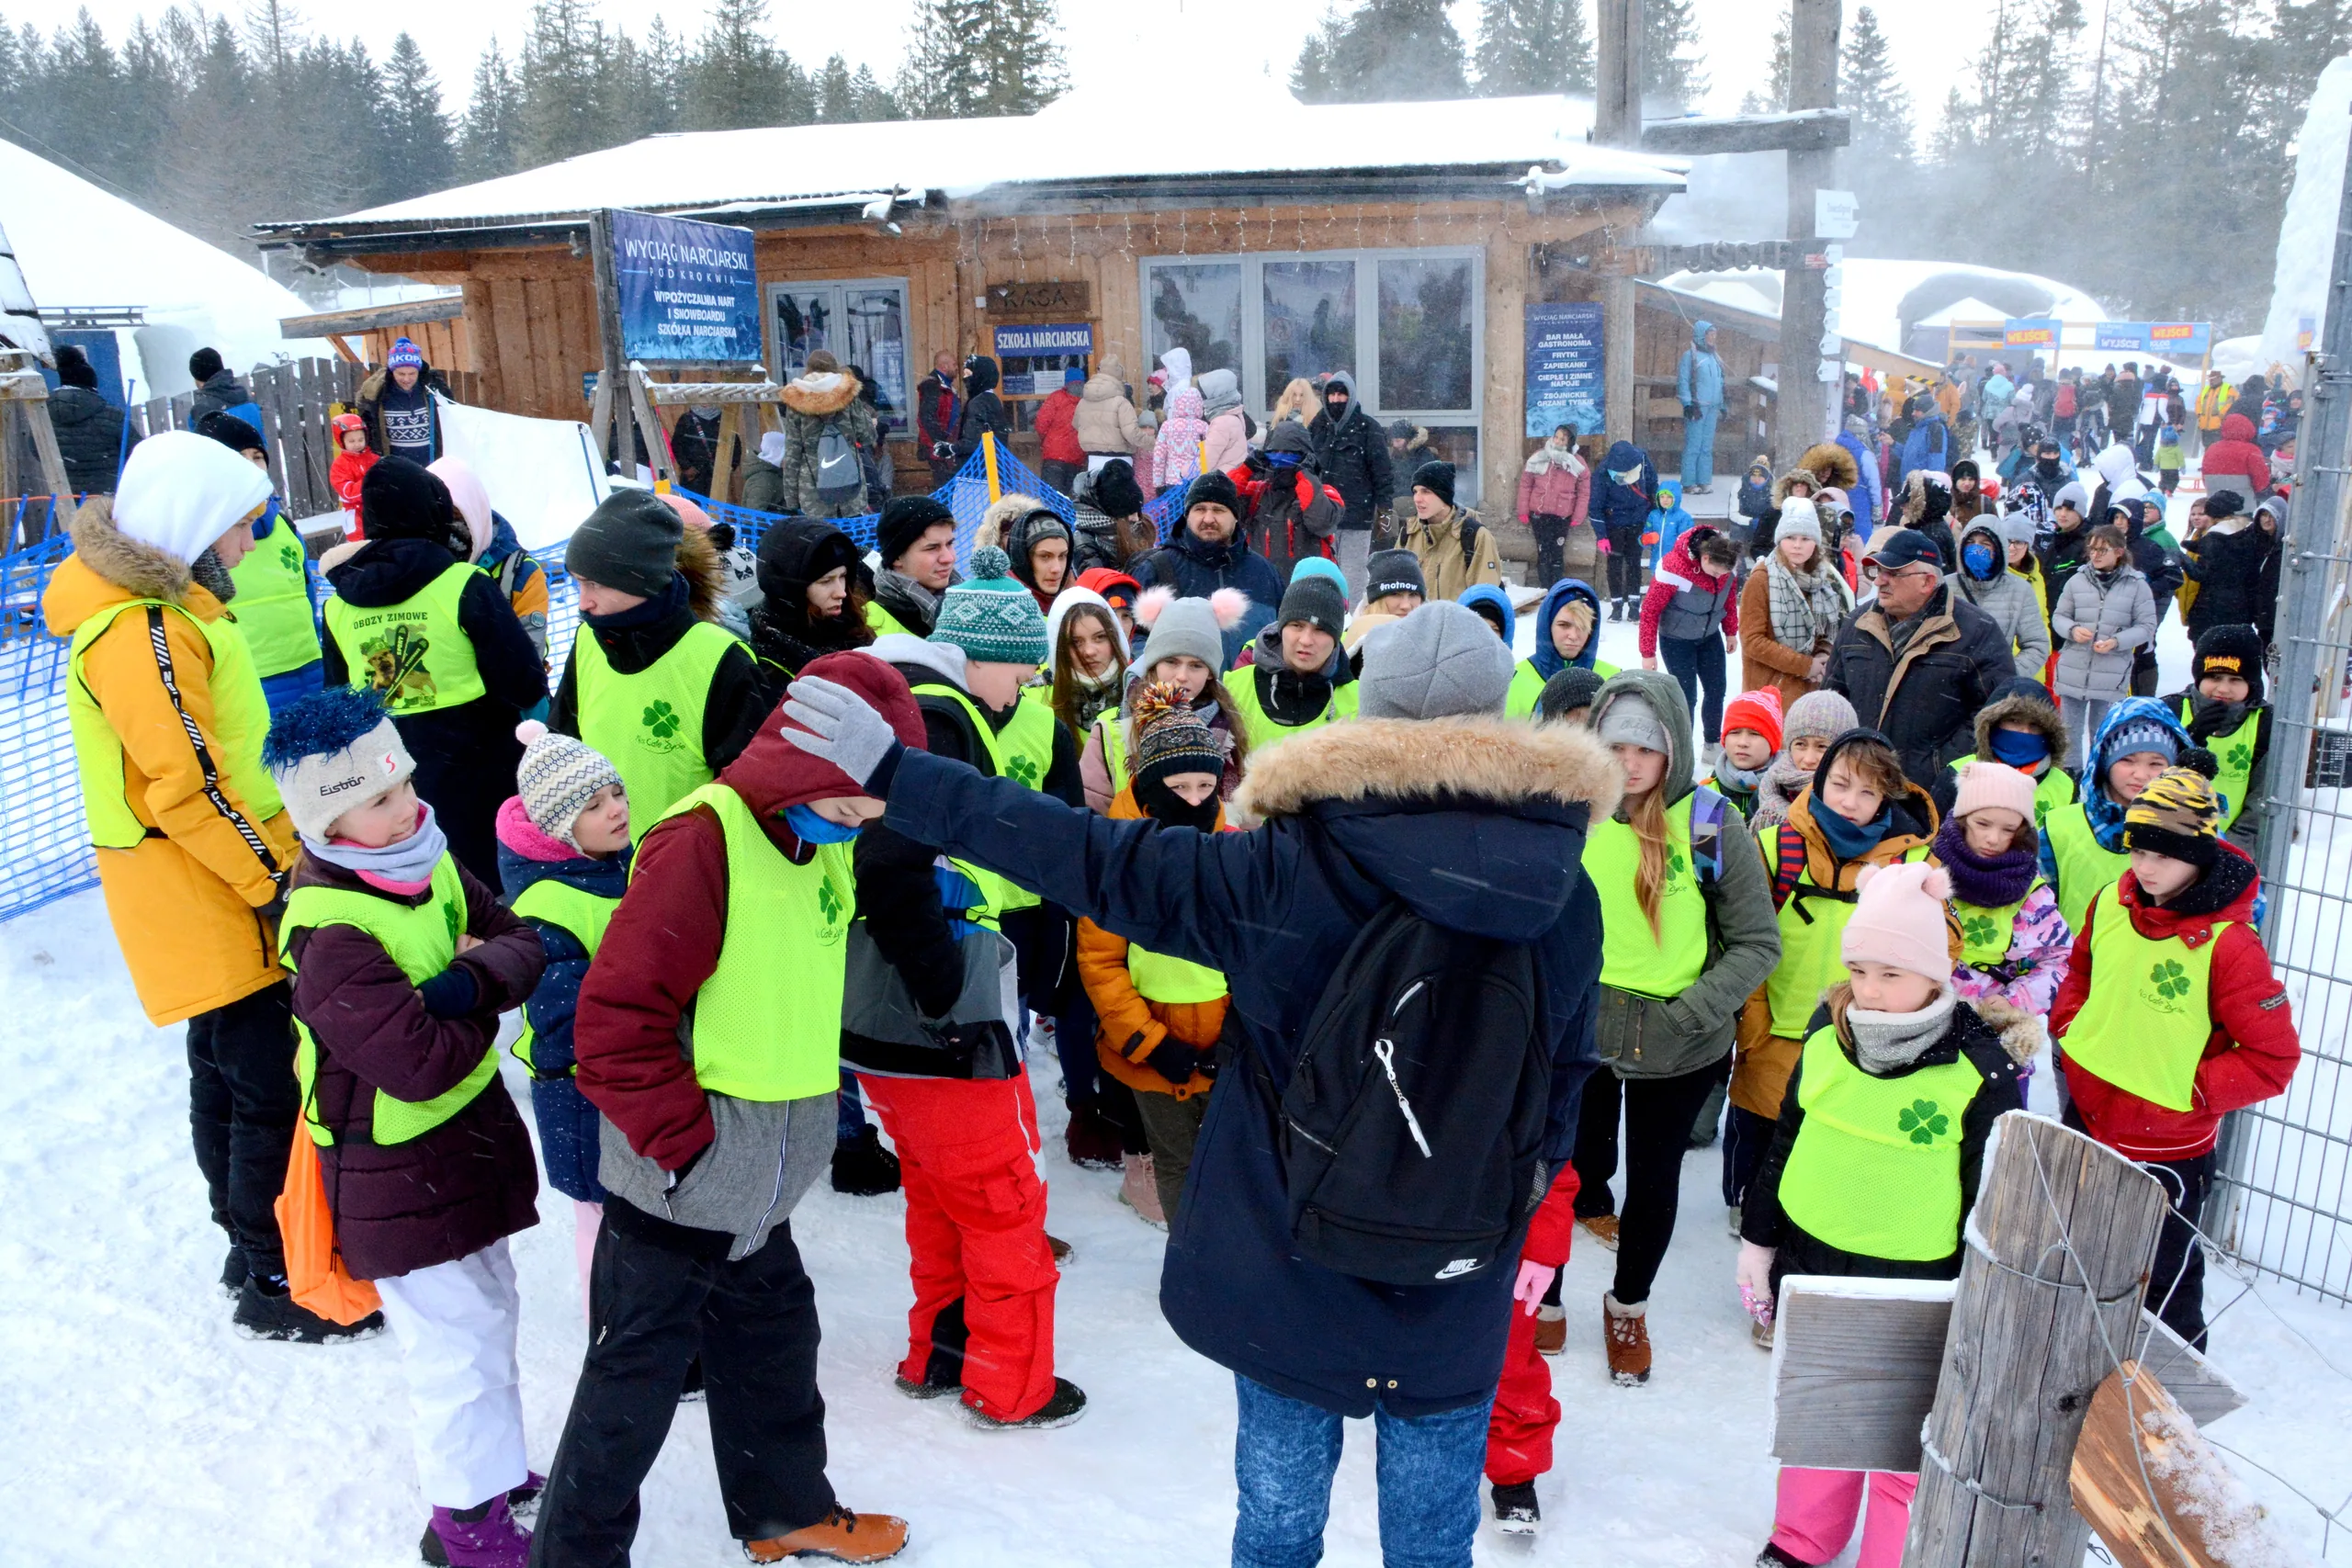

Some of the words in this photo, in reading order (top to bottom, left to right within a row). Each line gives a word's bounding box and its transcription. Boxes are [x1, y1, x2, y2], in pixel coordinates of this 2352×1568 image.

[625, 238, 678, 265] WYCIĄG
[680, 244, 748, 270] NARCIARSKI
[654, 289, 717, 306] WYPOŻYCZALNIA
[718, 295, 735, 308] NART
[1003, 288, 1068, 308] KASA
[673, 308, 726, 321] SNOWBOARDU
[658, 321, 691, 336] SZKÓŁKA
[693, 325, 737, 338] NARCIARSKA
[998, 332, 1031, 349] SZKOŁA
[1032, 330, 1090, 348] NARCIARSKA
[1538, 339, 1592, 348] GASTRONOMIA
[1543, 361, 1588, 369] ZAPIEKANKI
[1551, 379, 1580, 388] NAPOJE
[1380, 581, 1418, 592] #notnow
[353, 615, 383, 630] OBOZY
[387, 611, 429, 623] ZIMOWE
[396, 636, 404, 656] SPORT
[320, 775, 366, 797] Eisbär
[1442, 1258, 1478, 1273] NIKE
